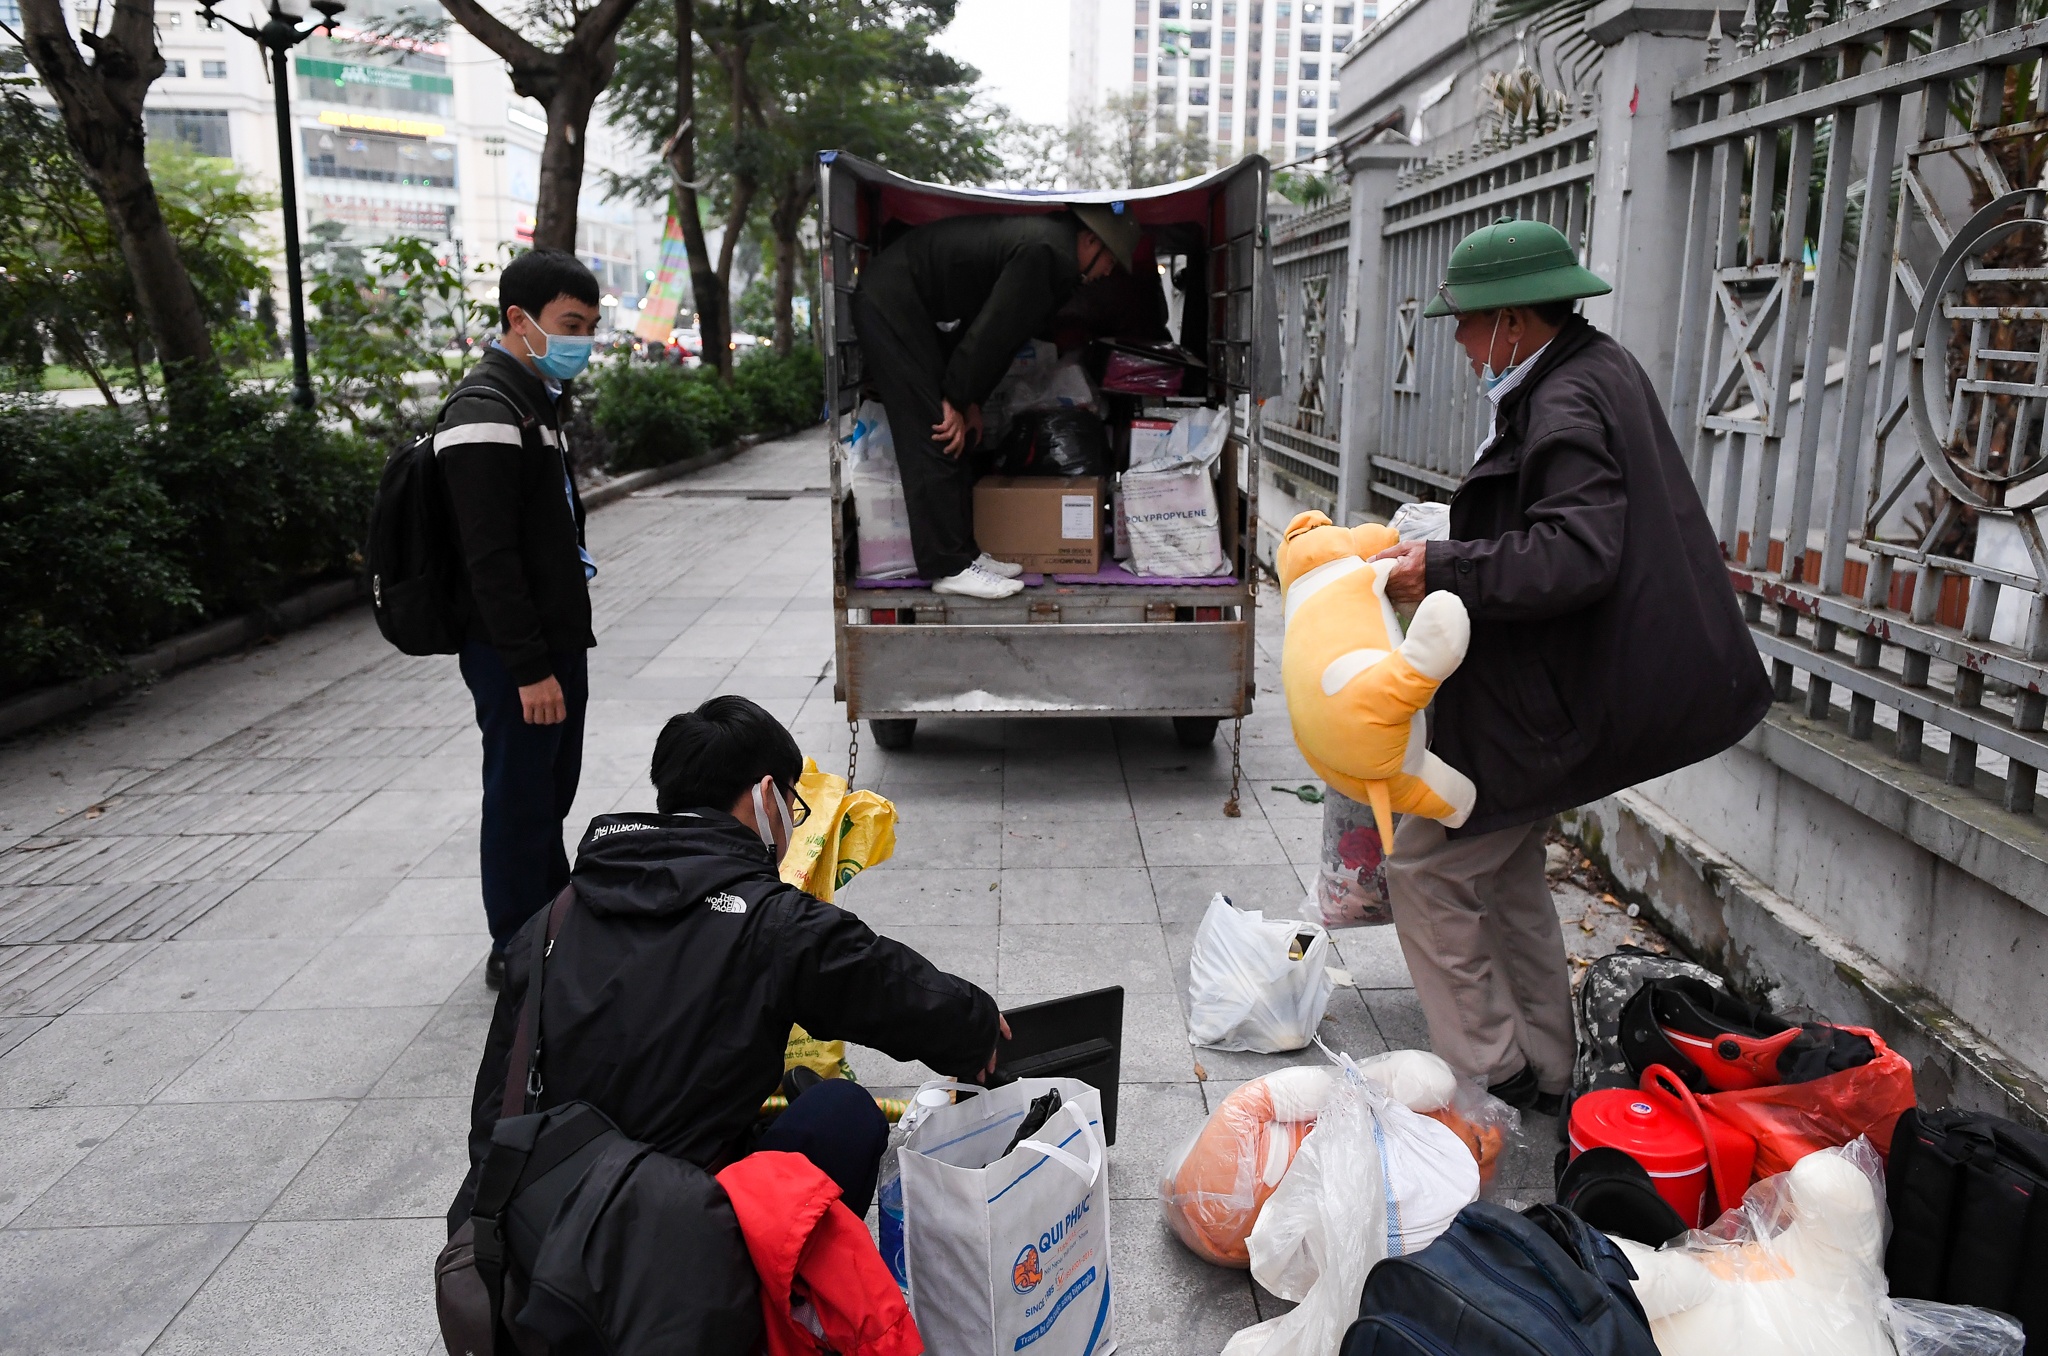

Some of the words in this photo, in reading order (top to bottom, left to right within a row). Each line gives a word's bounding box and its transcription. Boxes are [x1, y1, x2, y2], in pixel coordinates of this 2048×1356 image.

[1126, 509, 1207, 523] POLYPROPYLENE
[609, 823, 641, 834] NORTH
[705, 896, 734, 908] NORTH
[720, 892, 735, 901] THE
[711, 904, 733, 912] FACE
[1039, 1220, 1063, 1253] QUI
[1025, 1297, 1045, 1317] SINCE
[1020, 1329, 1039, 1345] Trang
